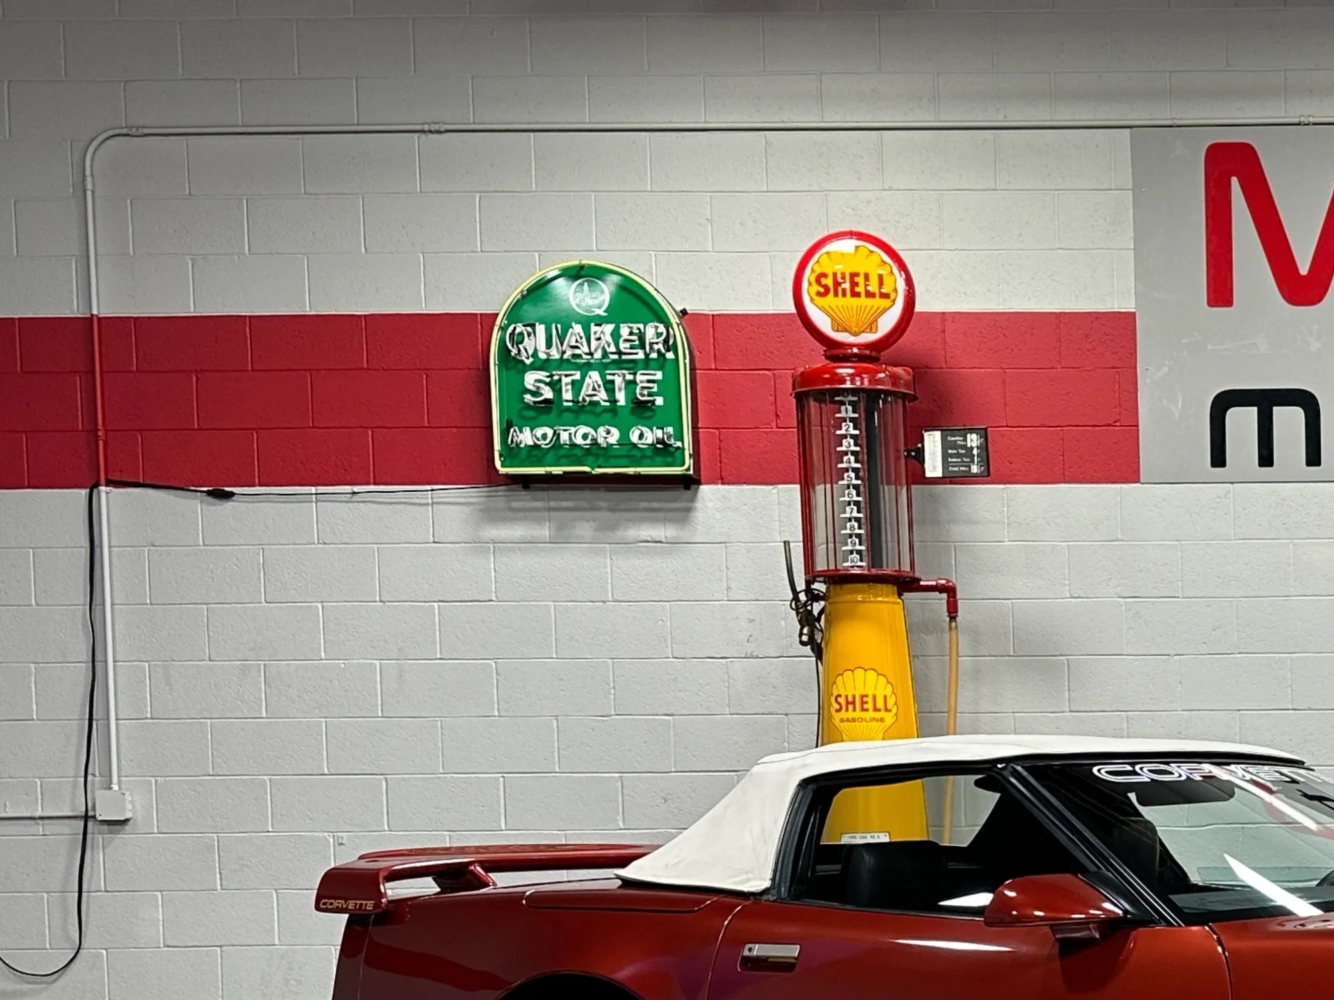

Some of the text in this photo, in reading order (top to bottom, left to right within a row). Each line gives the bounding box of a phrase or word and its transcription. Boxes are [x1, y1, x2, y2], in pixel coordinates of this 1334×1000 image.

[814, 270, 891, 301] SHELL
[505, 322, 676, 364] QUAKER
[523, 370, 665, 406] STATE
[508, 425, 683, 448] MOTOR OIL
[834, 693, 893, 713] SHELL
[319, 899, 375, 910] CORVETTE
